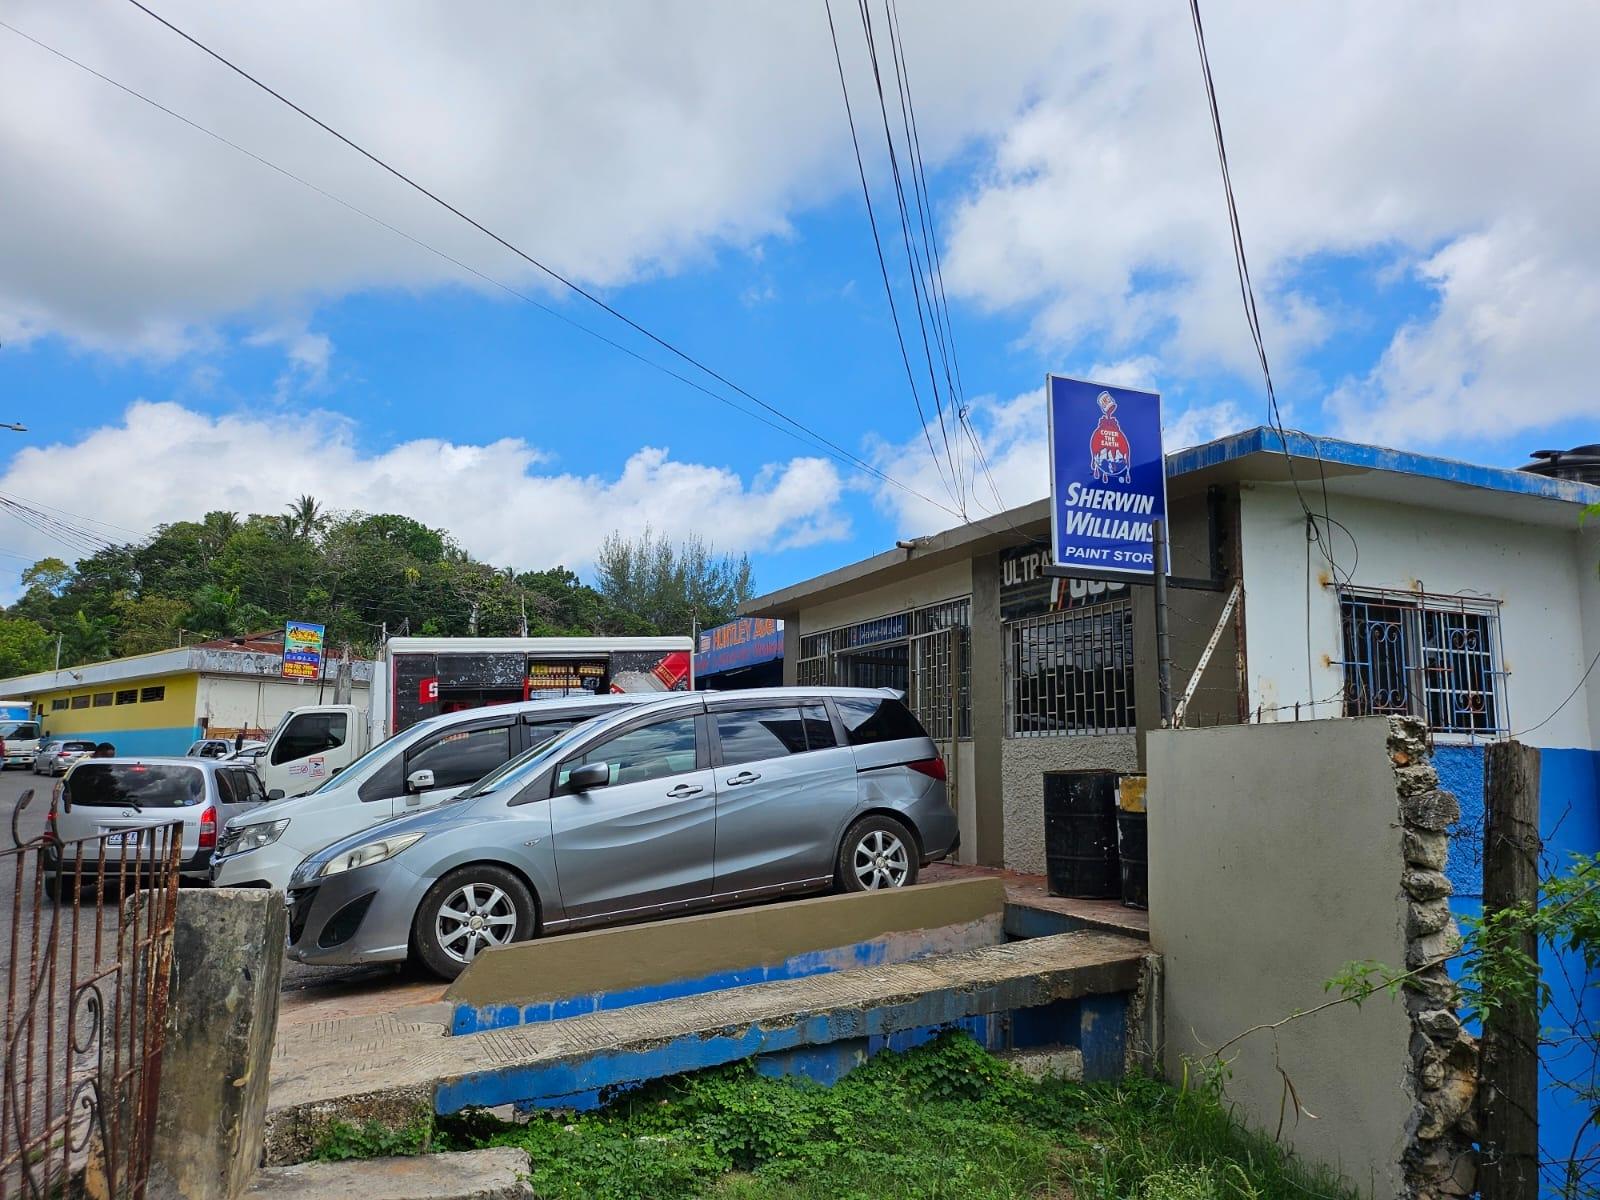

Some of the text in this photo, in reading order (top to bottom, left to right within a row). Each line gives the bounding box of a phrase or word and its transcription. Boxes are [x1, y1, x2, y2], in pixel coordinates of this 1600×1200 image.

[1100, 429, 1119, 437] COVER
[1100, 440, 1119, 448] EARTH
[1065, 482, 1155, 515] SHERWIN
[1065, 546, 1154, 564] PAINT STOR
